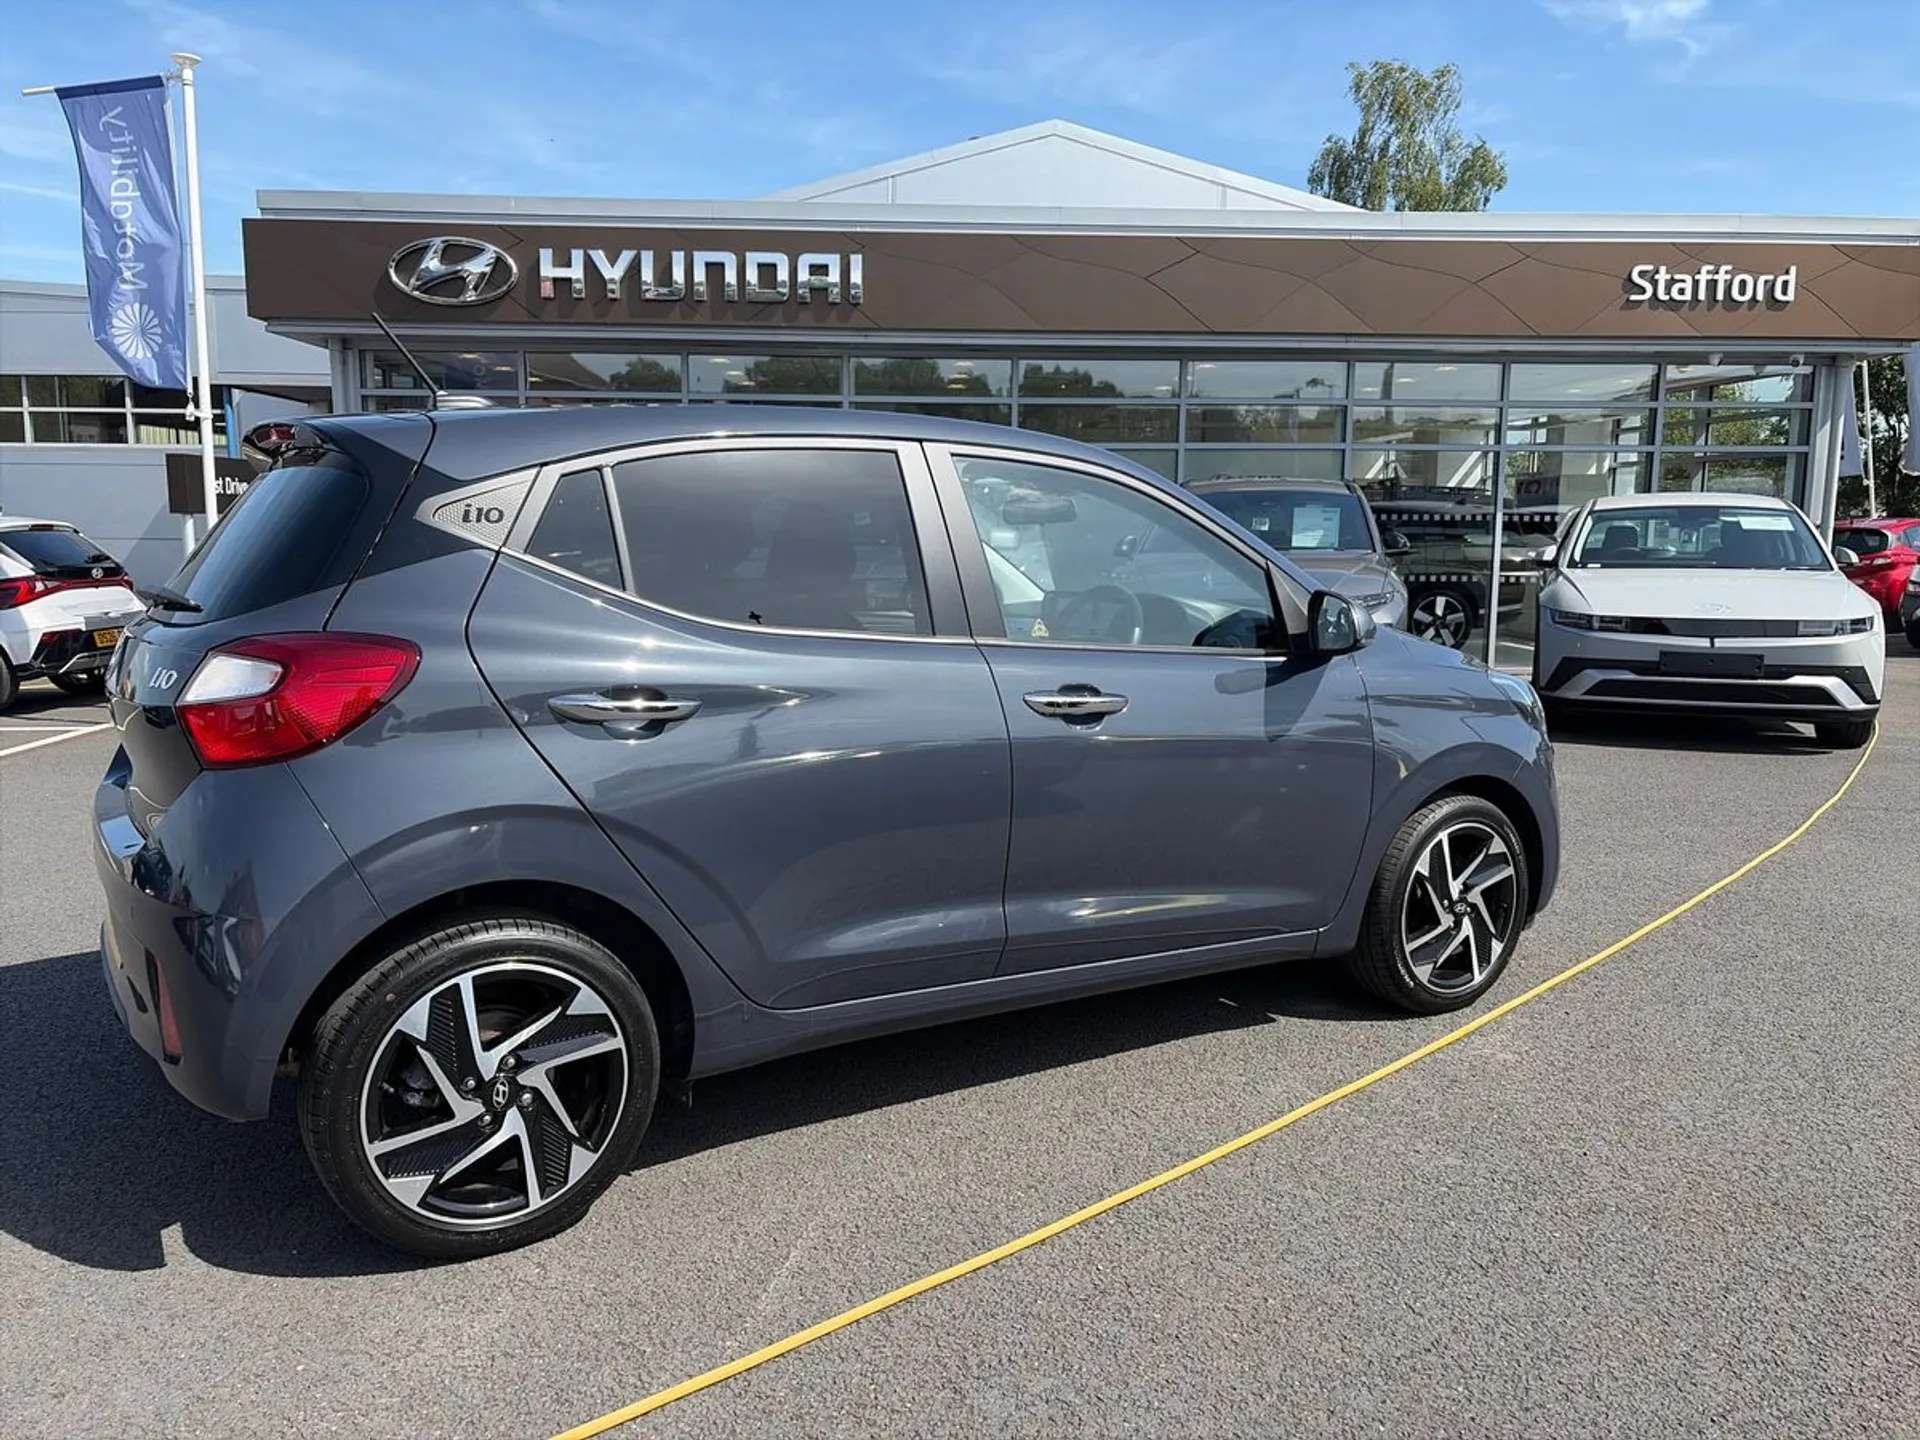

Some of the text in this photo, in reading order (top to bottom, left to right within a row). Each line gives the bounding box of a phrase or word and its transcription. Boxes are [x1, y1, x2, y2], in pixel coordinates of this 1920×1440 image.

[538, 247, 864, 304] HYUNDAI
[1628, 264, 1798, 304] Stafford
[462, 503, 504, 524] i10
